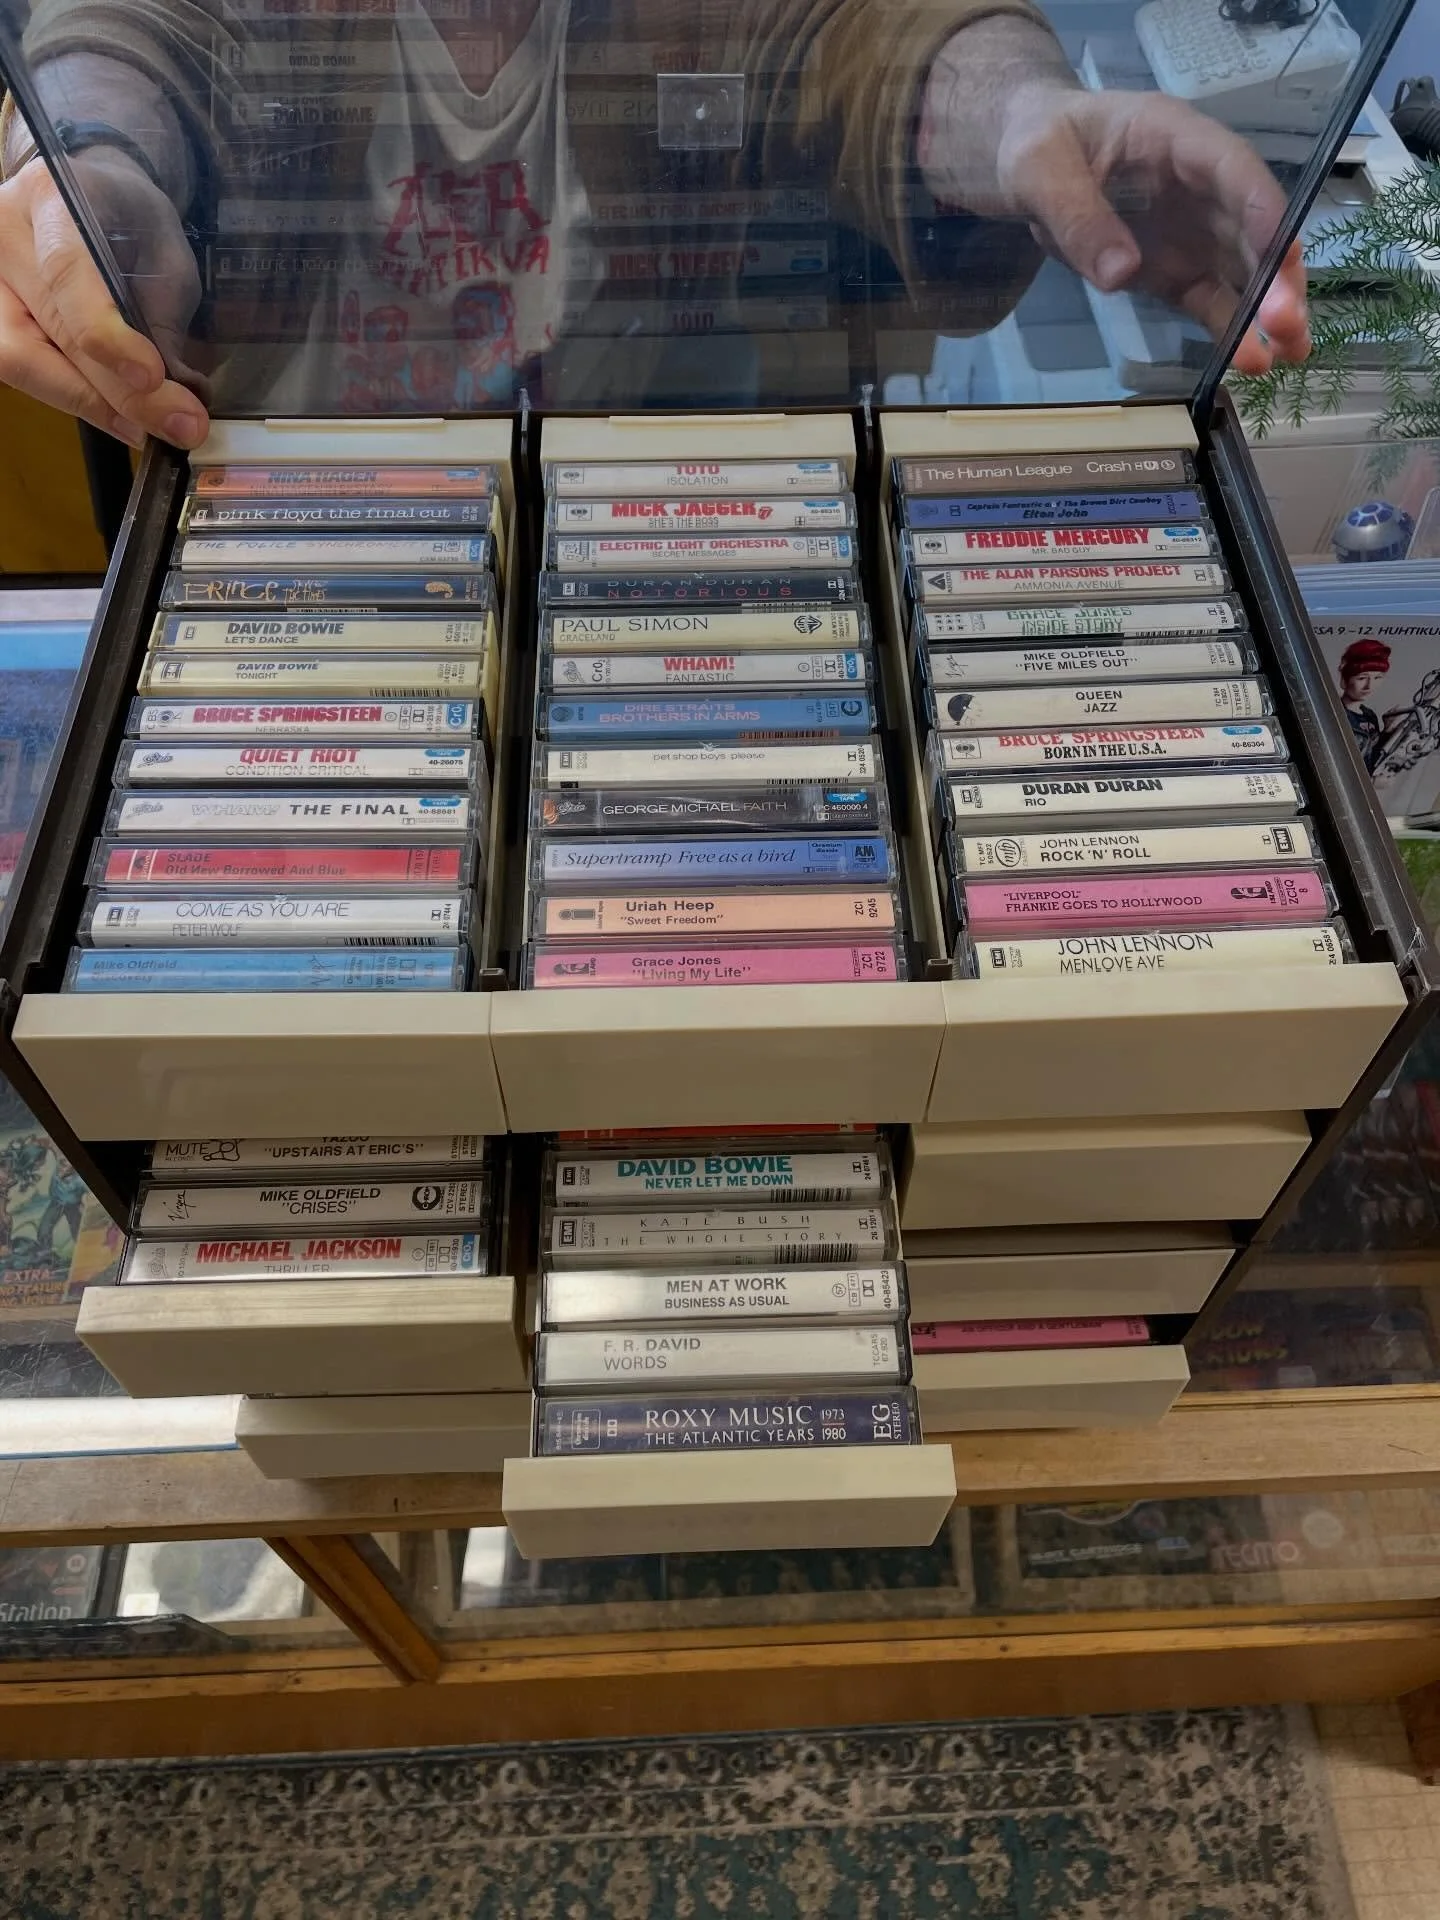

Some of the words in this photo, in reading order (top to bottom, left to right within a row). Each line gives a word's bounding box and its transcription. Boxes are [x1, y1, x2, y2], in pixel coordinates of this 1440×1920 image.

[674, 464, 720, 475] TOTO
[924, 468, 954, 481] The
[958, 466, 1012, 480] Human
[1015, 463, 1073, 479] League
[1086, 461, 1132, 473] Crash
[666, 476, 729, 486] ISOLATION
[217, 509, 267, 522] pink
[272, 508, 323, 522] floyd
[329, 508, 361, 519] the
[365, 507, 416, 519] final
[419, 508, 450, 518] cut
[612, 502, 669, 517] MICK
[676, 501, 757, 517] JAGGER
[1022, 509, 1052, 519] Elton
[1057, 508, 1089, 519] John
[599, 541, 663, 550] ELECTRIC
[667, 540, 704, 550] LIGHT
[709, 538, 789, 549] ORCHESTRA
[965, 531, 1049, 549] FREDDIE
[1053, 528, 1150, 547] MERCURY
[959, 569, 993, 581] THE
[996, 567, 1034, 580] ALAN
[1038, 566, 1110, 579] PARSONS
[1114, 565, 1183, 577] PROJECT
[607, 587, 793, 599] NOTORIOUS
[1014, 580, 1072, 592] AMMONIA
[1075, 579, 1125, 590] AVENUE
[227, 622, 282, 635] DAVID
[285, 622, 345, 635] BOWIE
[559, 618, 620, 632] PAUL
[627, 617, 709, 631] SIMON
[224, 636, 255, 644] LET'S
[257, 636, 299, 644] DANCE
[1023, 651, 1057, 660] MIKE
[1060, 649, 1126, 660] OLDFIELD
[236, 662, 275, 670] DAVID
[278, 662, 319, 670] BOWIE
[663, 656, 736, 672] WHAM!
[235, 672, 278, 680] TONIGHT
[665, 672, 736, 683] FANTASTIC
[1075, 690, 1123, 700] QUEEN
[1232, 683, 1242, 711] STEREO
[192, 707, 254, 723] BRUCE
[257, 706, 382, 723] SPRINGSTEEN
[624, 703, 660, 713] DIRE
[664, 703, 736, 713] STRAITS
[1084, 702, 1118, 713] JAZZ
[600, 711, 692, 723] BROTHERS
[694, 711, 710, 722] IN
[713, 711, 761, 722] ARMS
[999, 732, 1064, 748] BRUCE
[1070, 727, 1206, 745] SPRINGSTEEN
[239, 748, 301, 763] QUIET
[310, 748, 361, 763] RIOT
[653, 752, 671, 761] pet
[674, 752, 699, 762] shop
[700, 752, 727, 761] boys
[730, 752, 766, 761] please
[1043, 746, 1081, 760] BORN
[1082, 746, 1099, 758] IN
[1099, 744, 1127, 757] THE
[1127, 742, 1168, 756] U.S.A.
[225, 764, 304, 777] CONDITION
[309, 764, 370, 776] CRITICAL
[1022, 782, 1091, 796] DURAN
[1095, 778, 1163, 793] DURAN
[602, 804, 668, 815] GEORGE
[671, 803, 740, 813] MICHAEL
[743, 801, 787, 811] FAITH
[831, 803, 862, 811] 460000
[1024, 798, 1047, 807] RIO
[1039, 836, 1078, 849] JOHN
[1081, 835, 1140, 847] LENNON
[1274, 829, 1289, 851] EMI
[167, 853, 212, 863] SLADE
[565, 850, 672, 868] Supertramp
[677, 850, 719, 864] Free
[719, 854, 740, 864] as
[741, 853, 754, 864] a
[758, 849, 797, 863] bird
[1040, 850, 1083, 862] ROCK
[1087, 848, 1108, 861] 'N'
[1112, 847, 1151, 859] ROLL
[1004, 889, 1082, 901] "LIVERPOOL"
[1284, 879, 1299, 905] ZCIQ
[176, 902, 234, 917] COME
[236, 903, 264, 917] AS
[269, 903, 309, 917] YOU
[312, 902, 351, 917] ARE
[626, 900, 667, 911] Uriah
[674, 900, 715, 912] Heep
[854, 901, 864, 916] ZCI
[868, 898, 878, 918] 9245
[1005, 900, 1060, 913] FRANKIE
[1062, 899, 1099, 911] GOES
[1101, 899, 1120, 910] TO
[1121, 895, 1203, 908] HOLLYWOOD
[1058, 937, 1118, 956] JOHN
[1125, 933, 1214, 952] LENNON
[632, 957, 675, 967] Grace
[678, 956, 721, 966] Jones
[862, 953, 873, 969] ZCI
[875, 951, 886, 972] 9722
[1060, 957, 1132, 974] MENLOVE
[1135, 955, 1166, 969] AVE
[632, 968, 688, 981] "Living
[691, 968, 714, 981] My
[715, 966, 752, 980] Life"
[166, 1142, 210, 1157] MUTE
[617, 1158, 696, 1177] DAVID
[703, 1155, 794, 1174] BOWIE
[645, 1176, 694, 1189] NEVER
[695, 1175, 723, 1188] LET
[726, 1175, 748, 1187] ME
[751, 1174, 794, 1186] DOWN
[259, 1190, 300, 1202] MIKE
[303, 1187, 381, 1201] OLDFIELD
[562, 1222, 573, 1243] EMI
[197, 1241, 295, 1263] MICHAEL
[300, 1238, 402, 1261] JACKSON
[667, 1280, 704, 1294] MEN
[707, 1279, 730, 1292] AT
[734, 1277, 786, 1291] WORK
[880, 1270, 891, 1309] 40-85423
[664, 1297, 725, 1309] BUSINESS
[728, 1296, 745, 1307] AS
[748, 1295, 790, 1306] USUAL
[603, 1339, 617, 1352] F.
[623, 1339, 640, 1352] R.
[646, 1337, 701, 1351] DAVID
[604, 1356, 667, 1370] WORDS
[645, 1408, 717, 1429] ROXY
[728, 1405, 813, 1427] MUSIC
[821, 1408, 845, 1421] 1973
[892, 1402, 902, 1440] STEREO
[645, 1432, 674, 1446] THE
[681, 1430, 763, 1444] ATLANTIC
[766, 1428, 814, 1442] YEARS
[821, 1428, 847, 1441] 1980
[1213, 1538, 1300, 1572] TECMO
